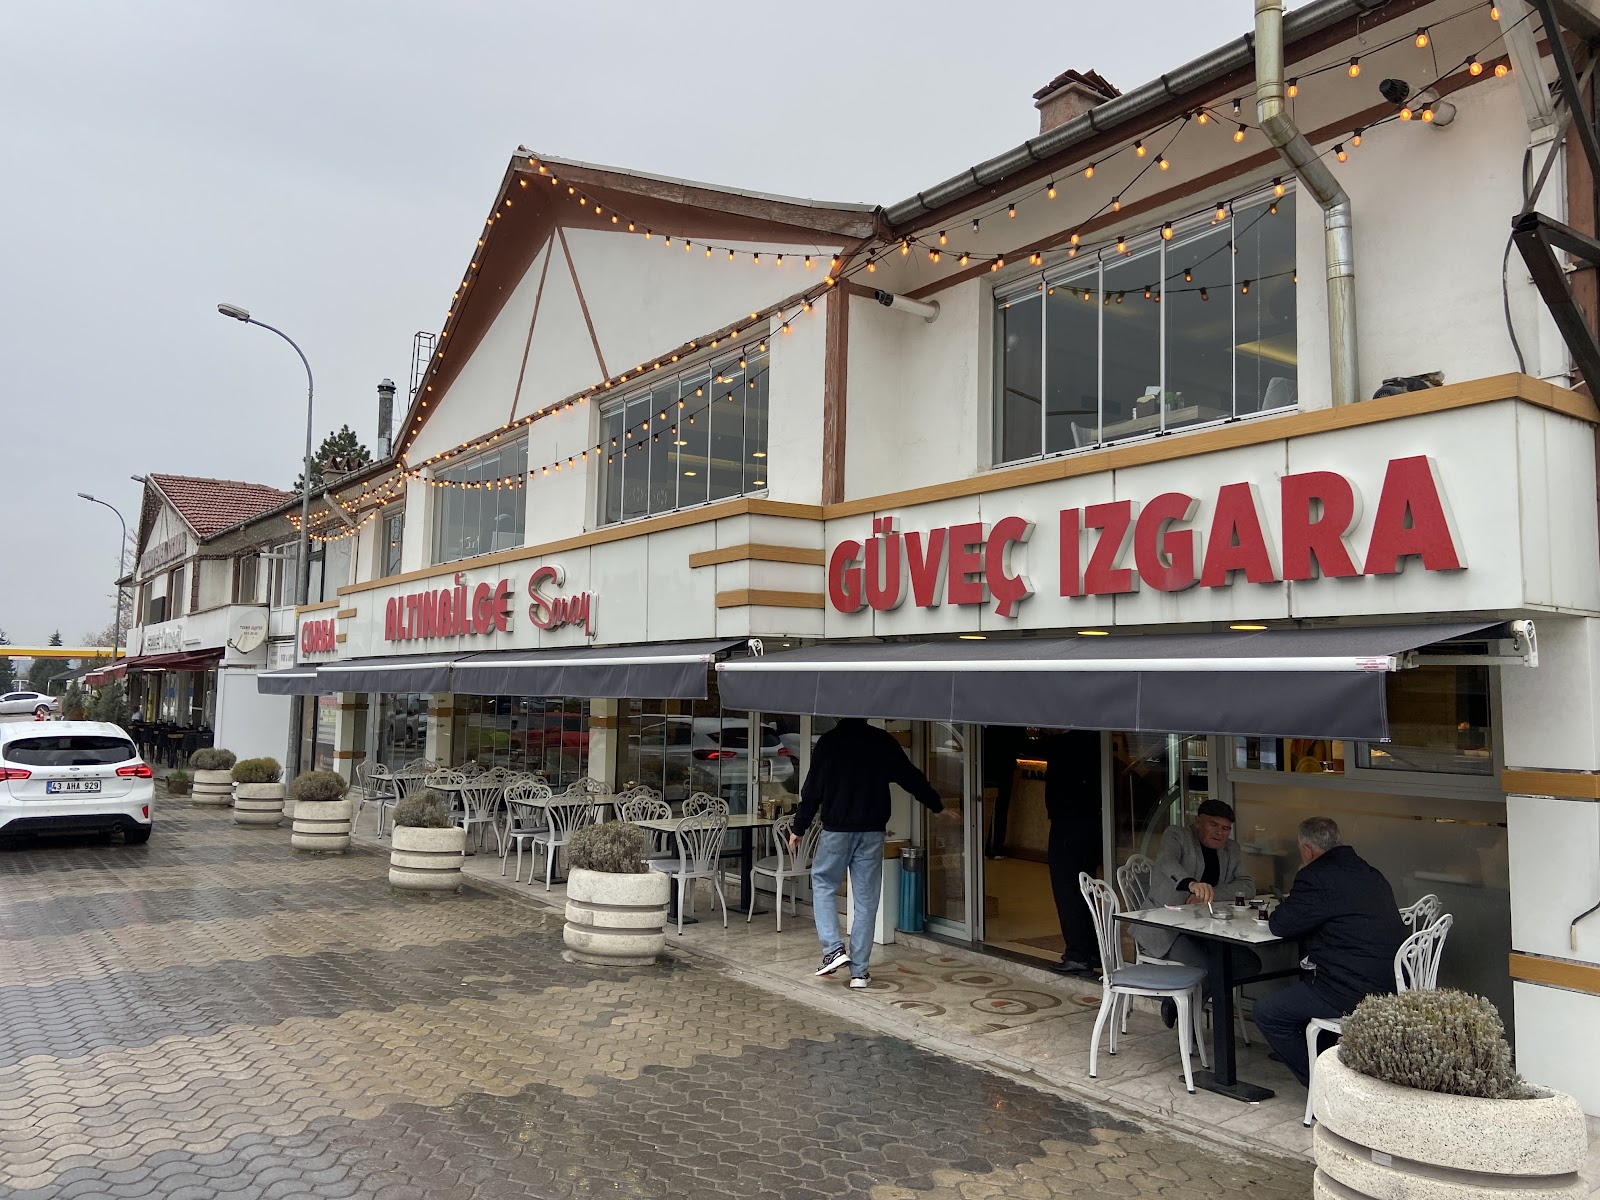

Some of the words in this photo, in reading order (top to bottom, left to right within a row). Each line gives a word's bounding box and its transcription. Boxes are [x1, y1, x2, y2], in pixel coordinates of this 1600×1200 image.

[828, 515, 1034, 618] GÜVEÇ
[1059, 454, 1468, 598] IZGARA
[385, 572, 514, 641] ALTINBİLGE
[528, 564, 597, 640] Saray
[302, 618, 336, 658] ÇORBA
[53, 781, 62, 790] 43
[66, 781, 81, 790] AHA
[84, 781, 99, 790] 929
